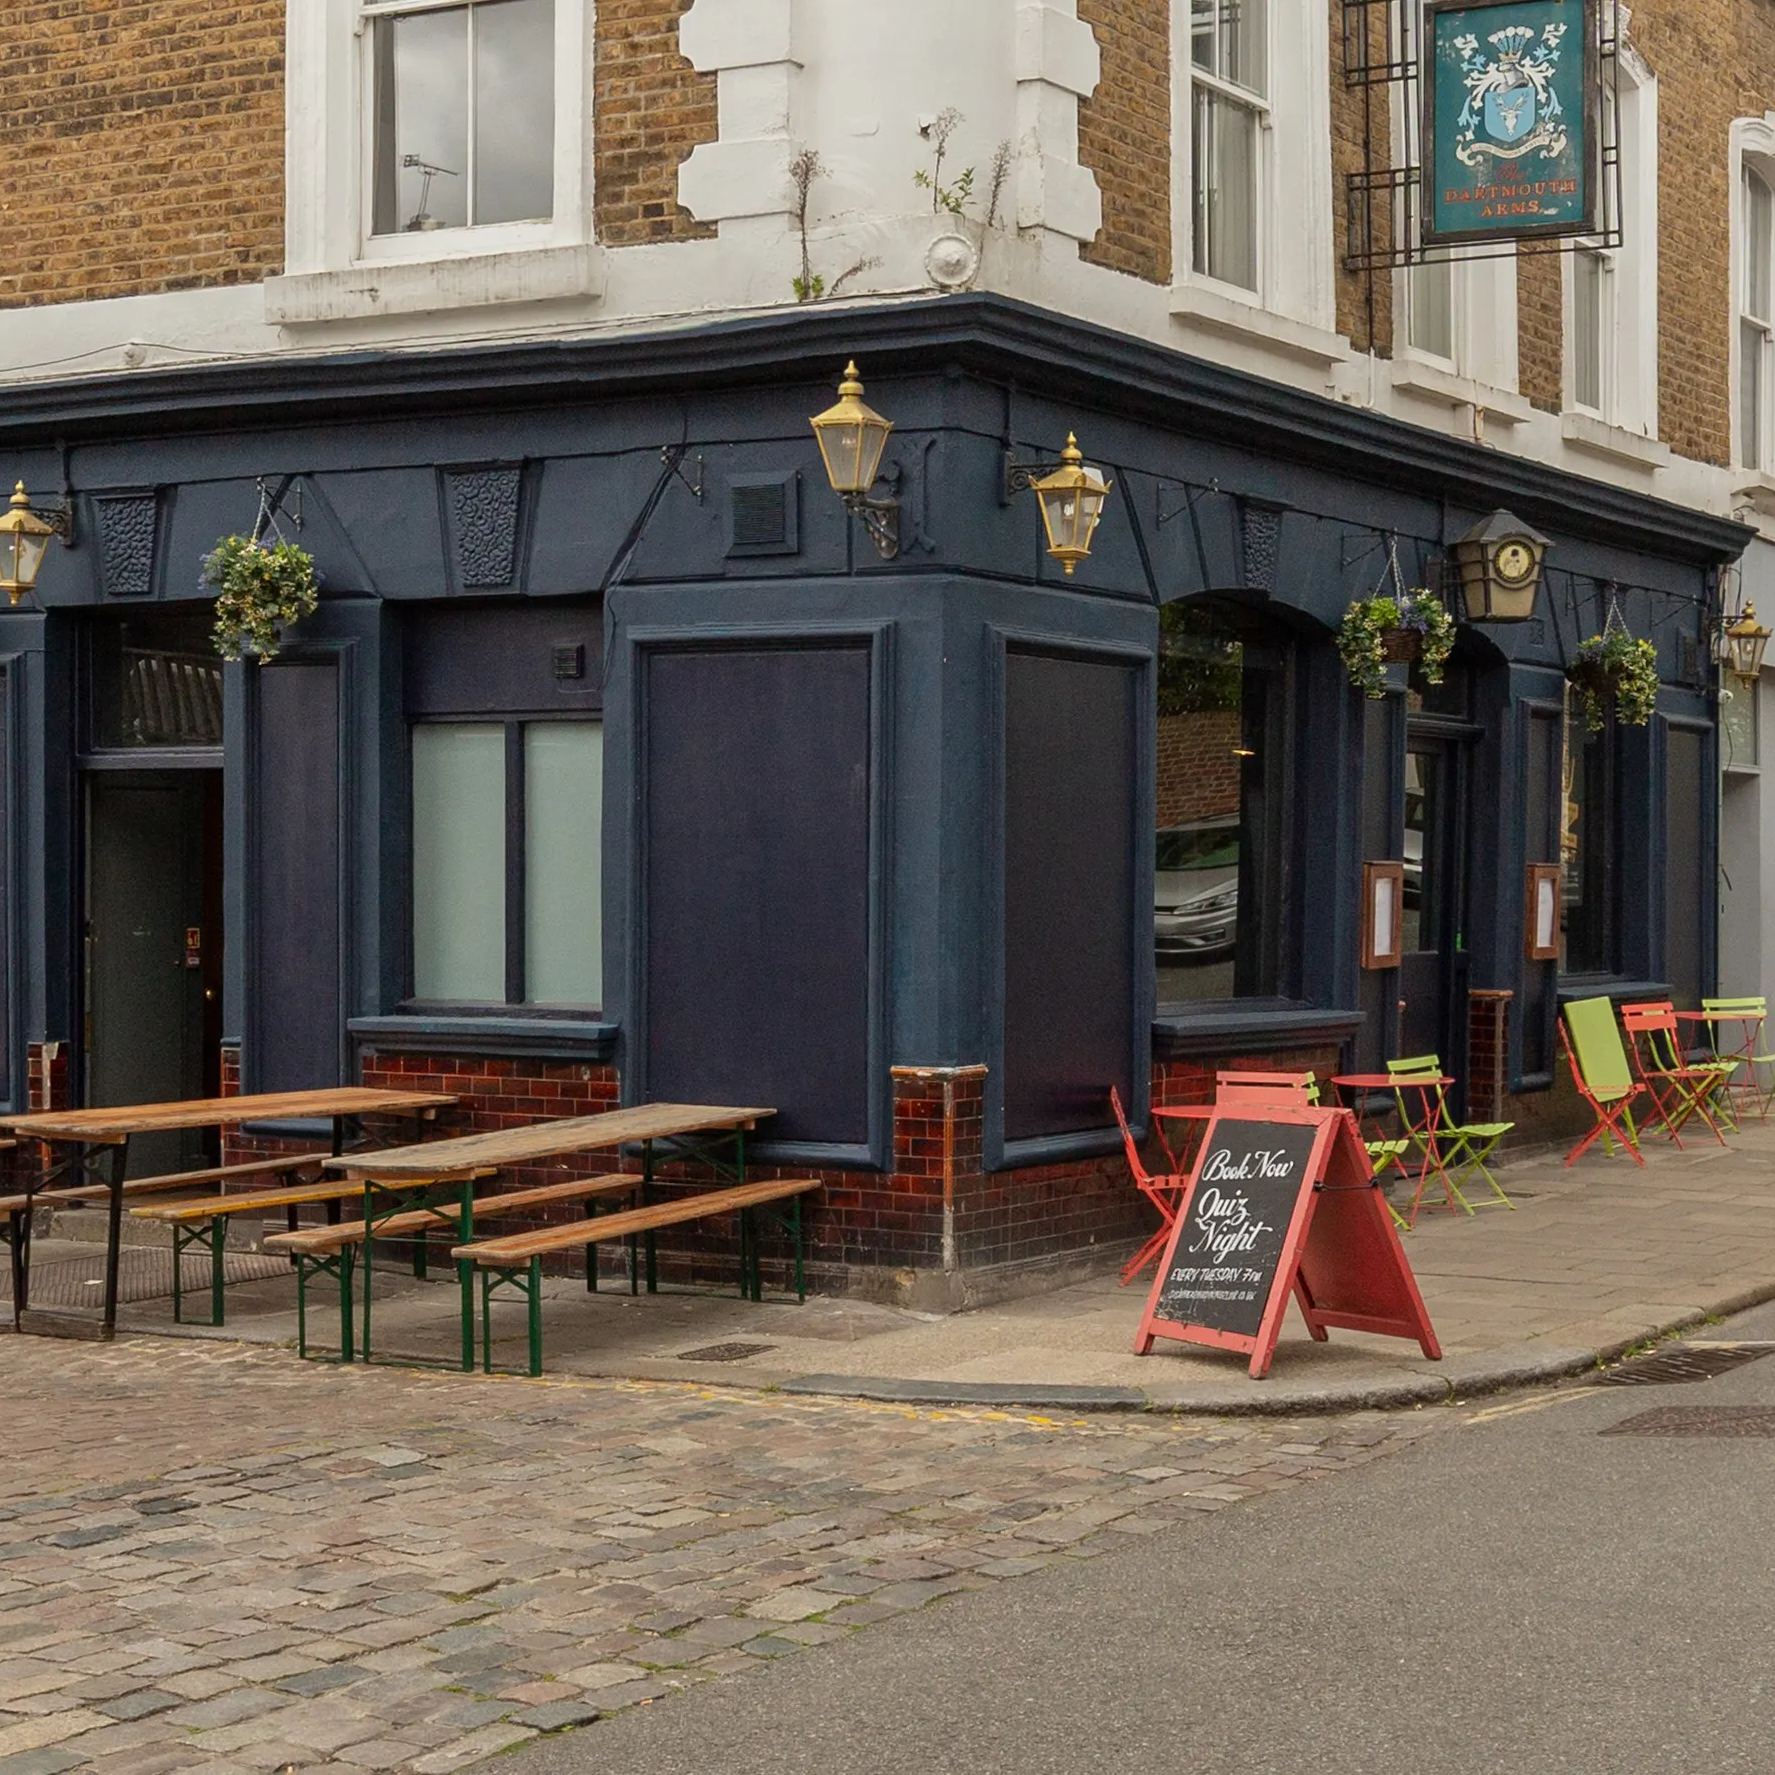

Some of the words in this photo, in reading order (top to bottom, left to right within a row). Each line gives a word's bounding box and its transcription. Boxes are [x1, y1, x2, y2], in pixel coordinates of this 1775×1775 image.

[1445, 179, 1576, 202] DARTMOUTH
[1481, 199, 1540, 217] ARMS
[1201, 1149, 1252, 1181] Book
[1248, 1149, 1293, 1178] Now
[1194, 1187, 1252, 1230] Quiz
[1188, 1220, 1274, 1264] Night
[1170, 1267, 1200, 1282] EVERY
[1199, 1267, 1243, 1282] TUESDAY
